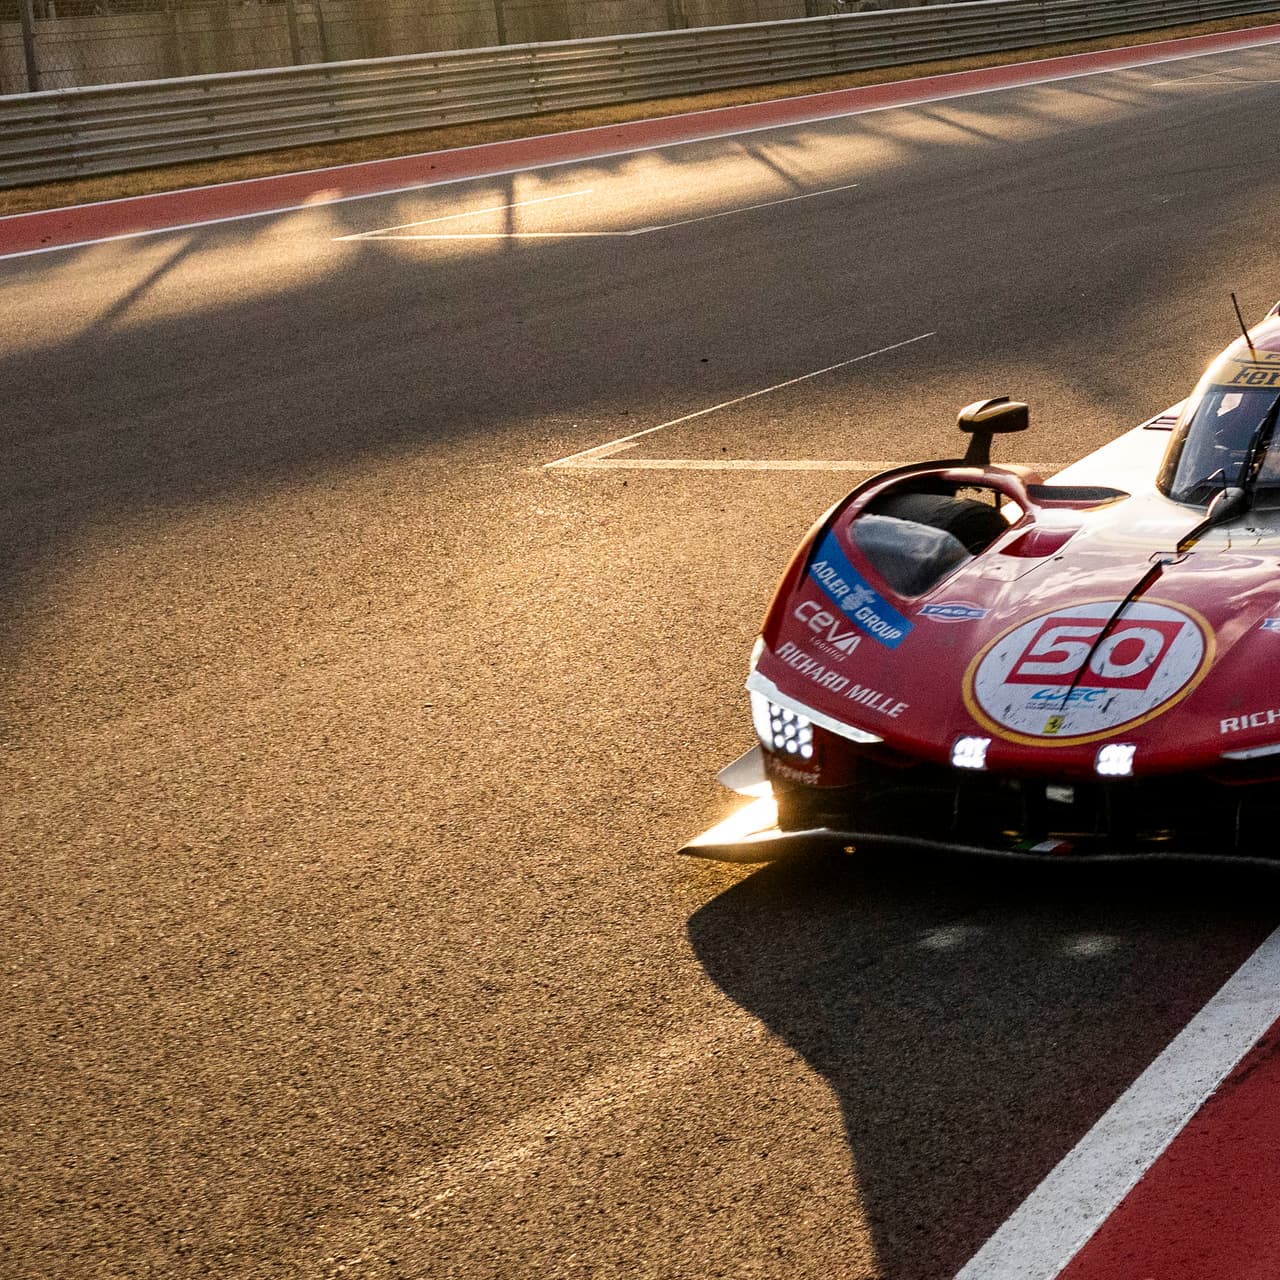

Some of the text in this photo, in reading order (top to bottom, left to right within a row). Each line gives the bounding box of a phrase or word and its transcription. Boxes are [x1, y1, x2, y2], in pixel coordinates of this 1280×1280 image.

[811, 560, 902, 640] ADLER GROUP
[775, 641, 910, 718] RICHARD MILLE
[1016, 625, 1165, 678] 50
[1031, 687, 1108, 702] WEC
